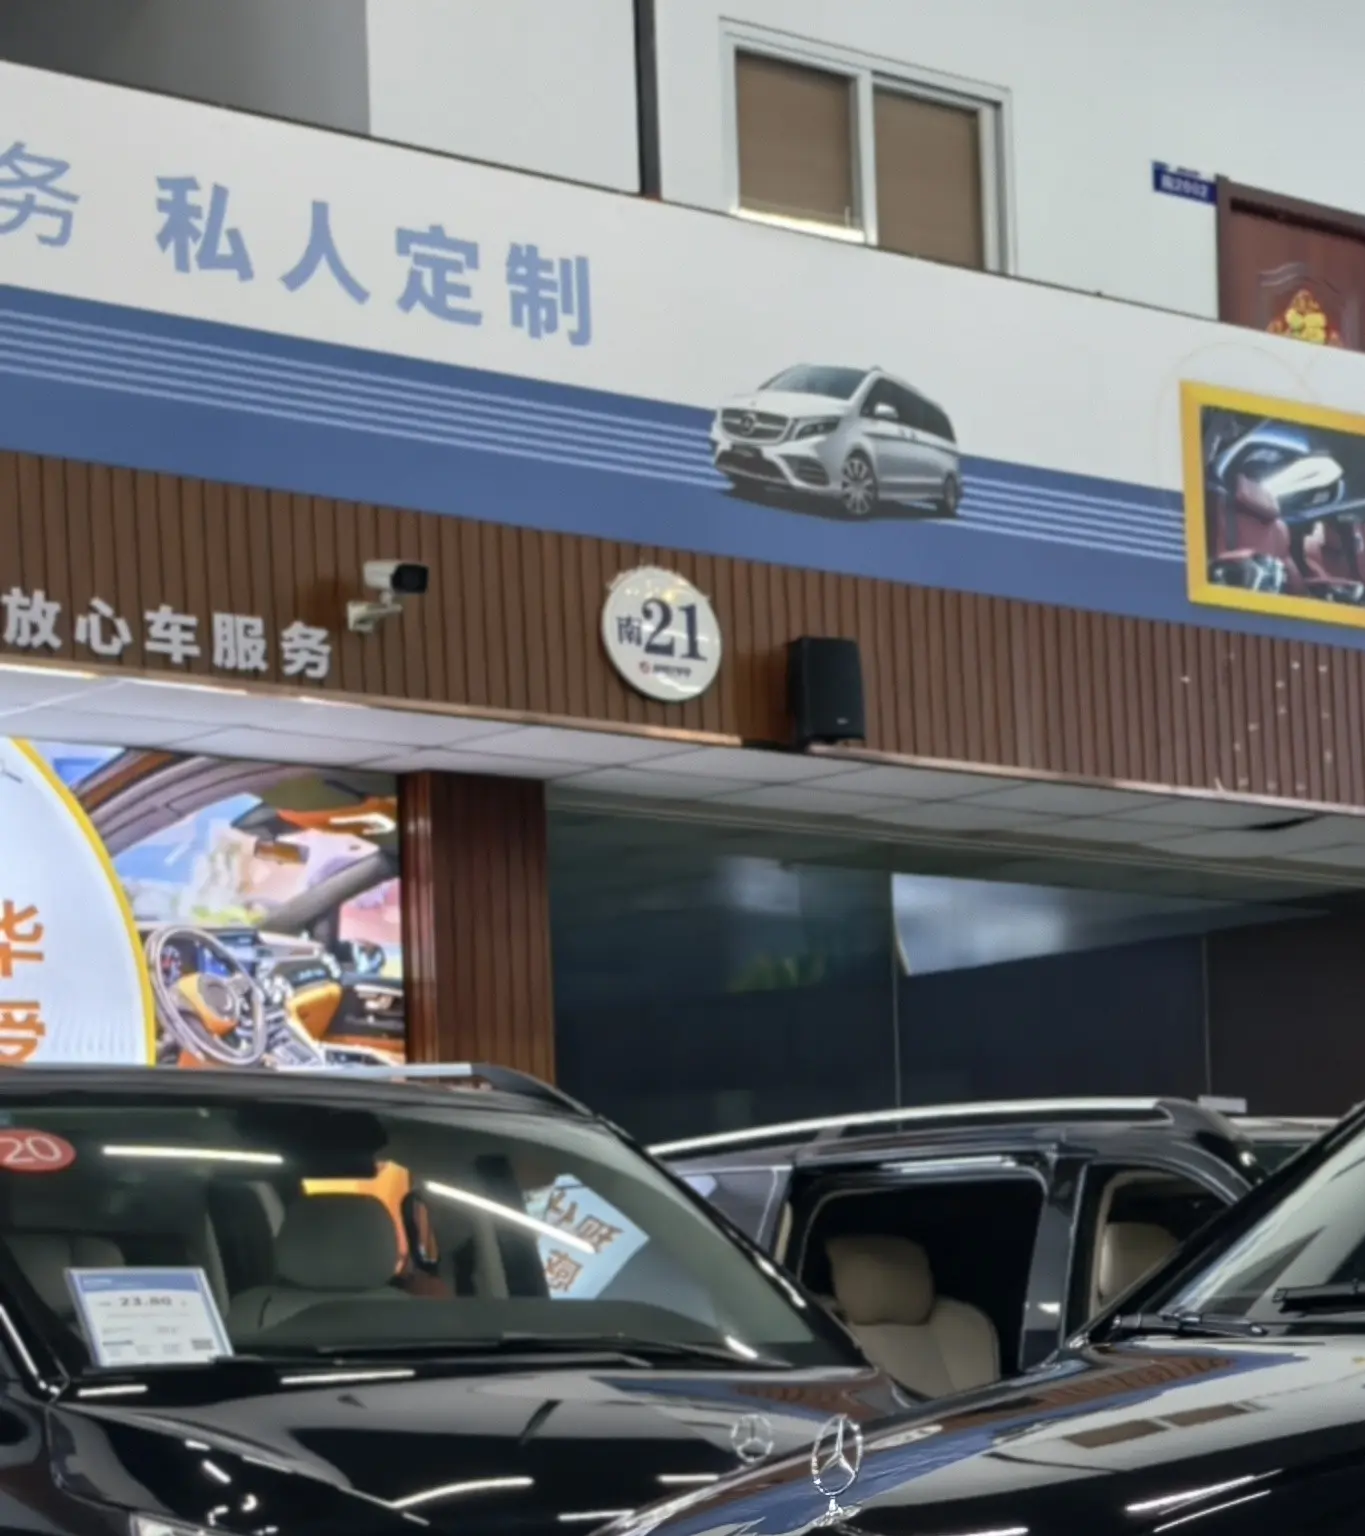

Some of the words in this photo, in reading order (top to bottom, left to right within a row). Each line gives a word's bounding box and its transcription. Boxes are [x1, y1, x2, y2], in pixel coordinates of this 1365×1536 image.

[155, 176, 593, 347] 私人定制
[1, 586, 331, 678] 放心车服务
